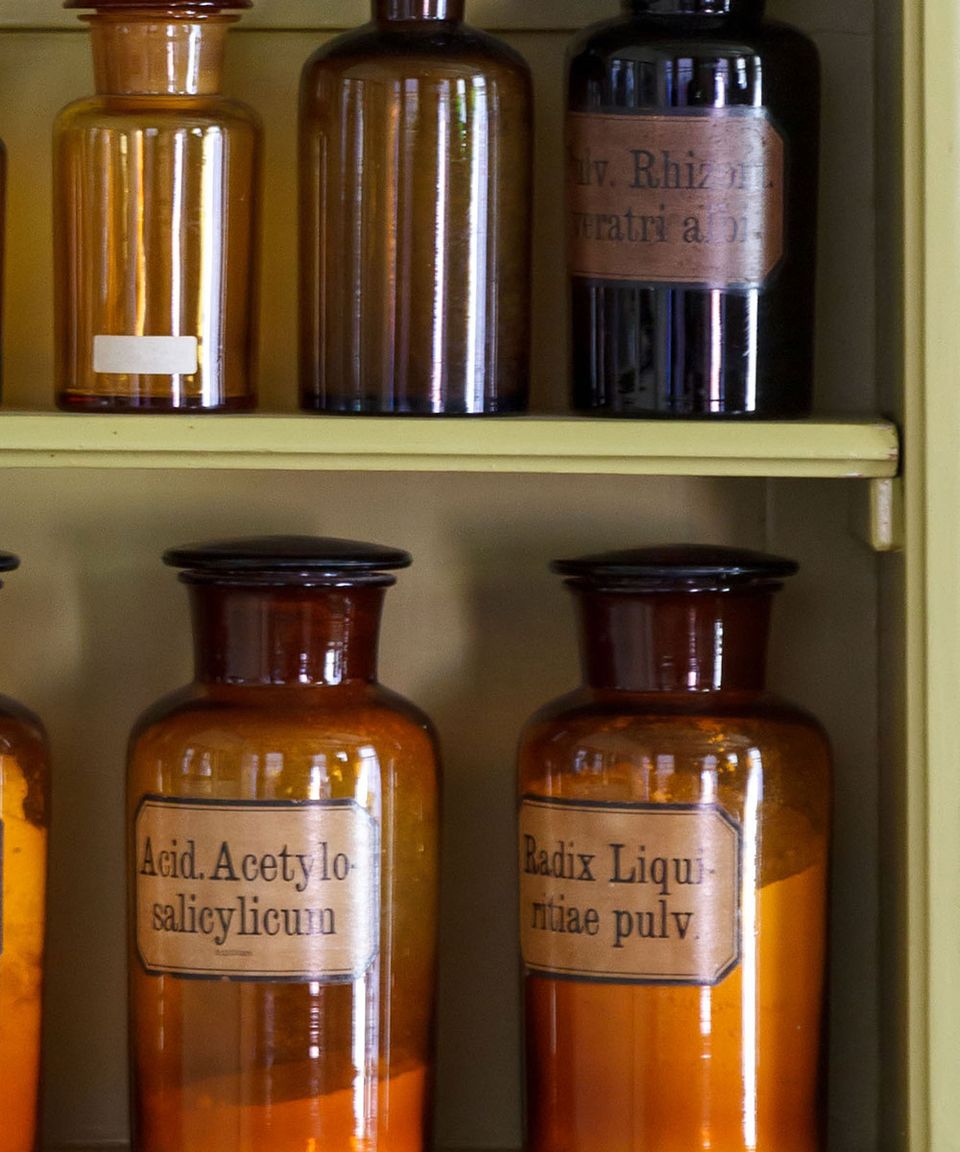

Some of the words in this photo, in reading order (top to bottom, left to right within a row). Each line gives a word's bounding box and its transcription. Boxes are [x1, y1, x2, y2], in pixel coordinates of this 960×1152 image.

[523, 834, 596, 882] Radix
[152, 893, 337, 946] salicylicum
[612, 899, 702, 948] pulv.
